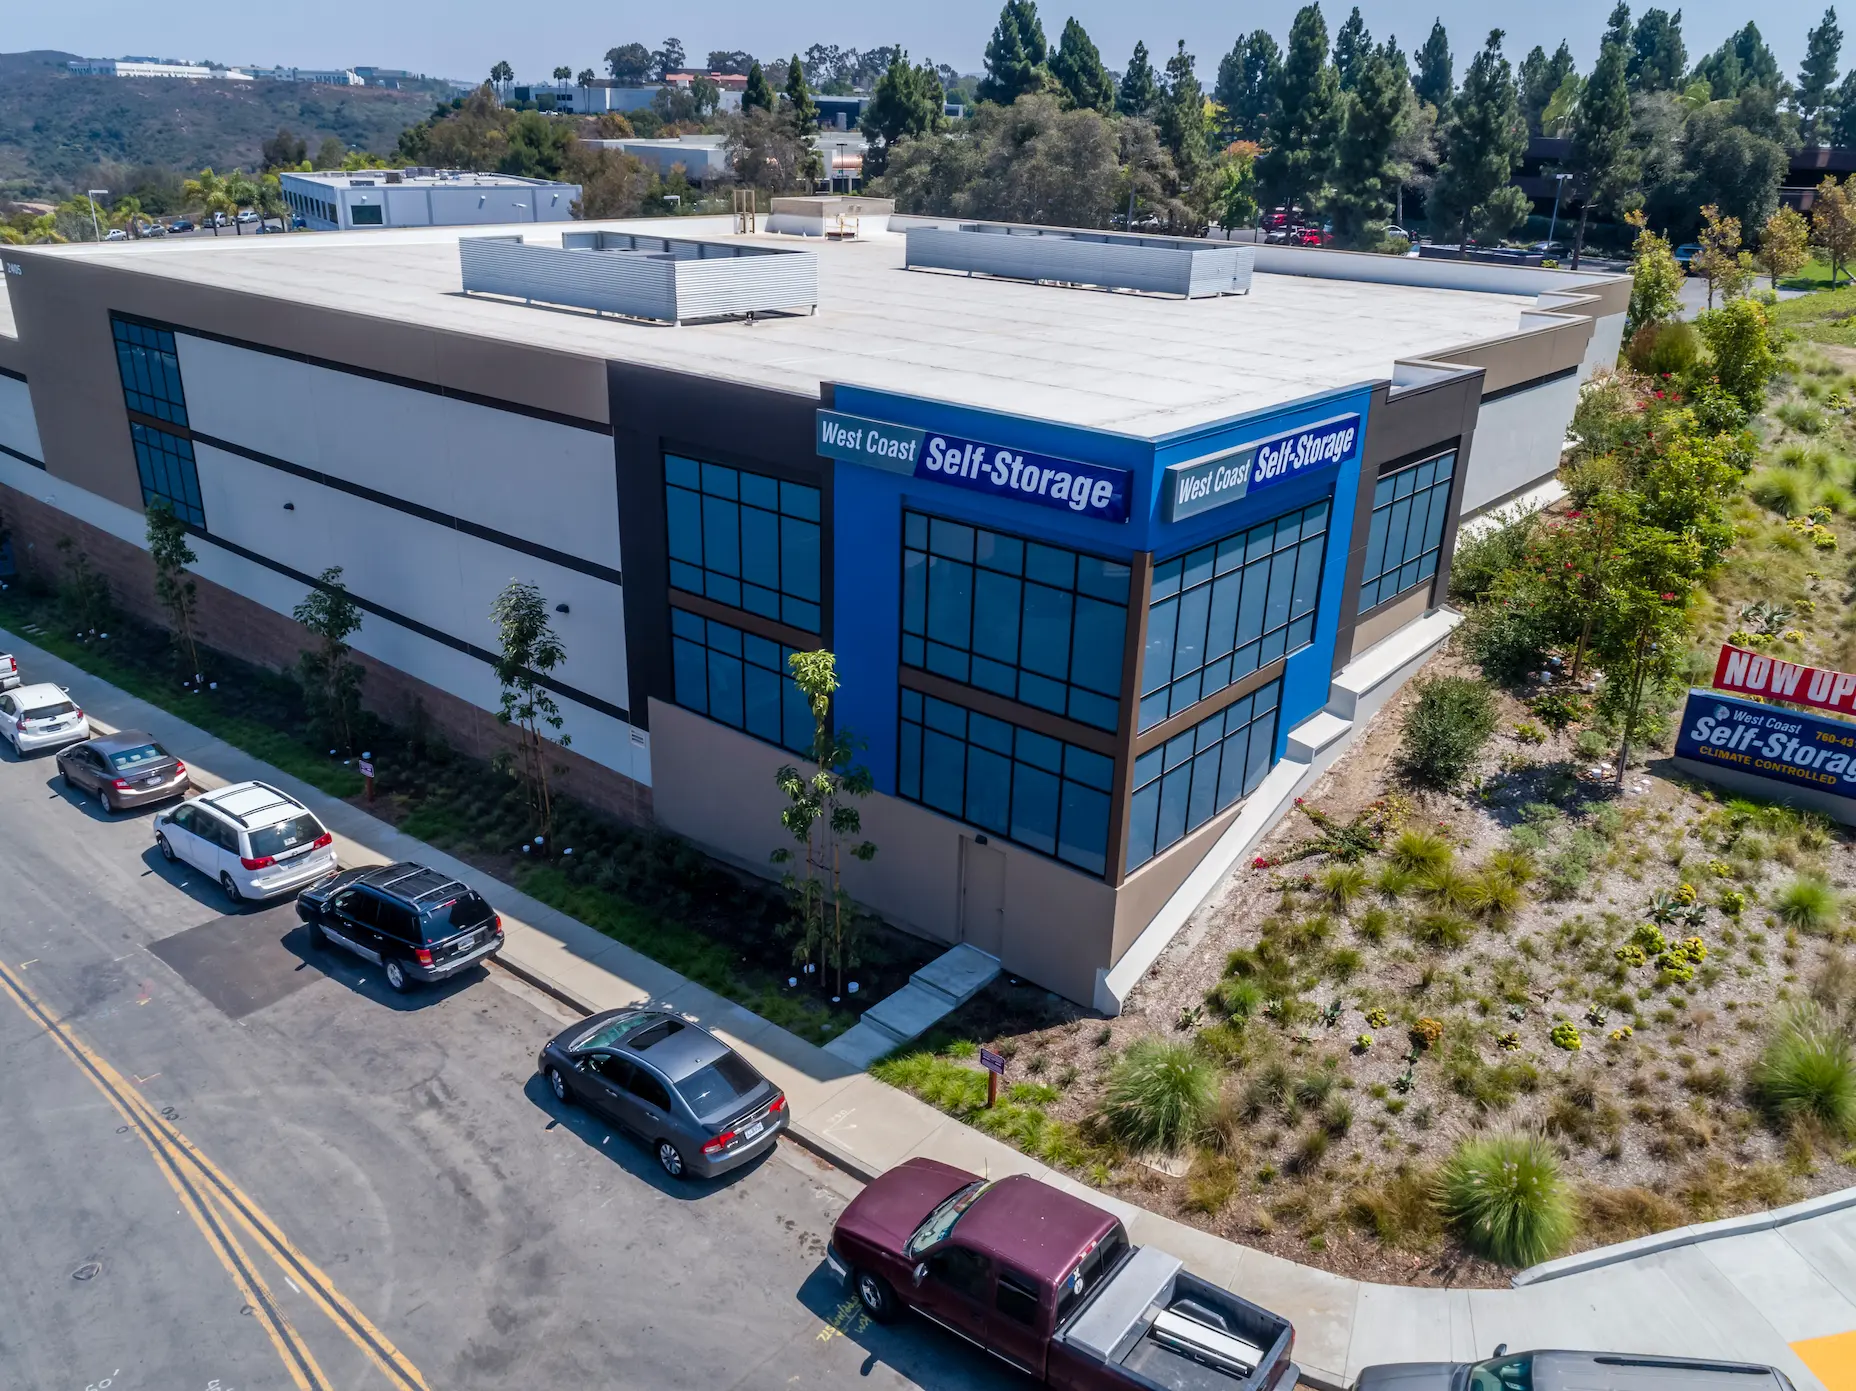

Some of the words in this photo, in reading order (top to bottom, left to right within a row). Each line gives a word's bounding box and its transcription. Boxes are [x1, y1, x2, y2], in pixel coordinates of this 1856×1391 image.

[822, 420, 861, 450] West
[866, 430, 916, 461] Coast
[926, 437, 1113, 511] Self-Storage
[1179, 471, 1212, 504] West
[1214, 459, 1250, 492] Coast
[1254, 427, 1354, 482] Self-Storage
[1723, 651, 1805, 697] NOW
[1808, 670, 1856, 710] OP
[1733, 710, 1764, 726] West
[1765, 717, 1802, 735] Coast
[1816, 731, 1856, 748] 760-43
[1699, 745, 1752, 765] CLIMATE
[1754, 759, 1837, 785] CONTROLLED
